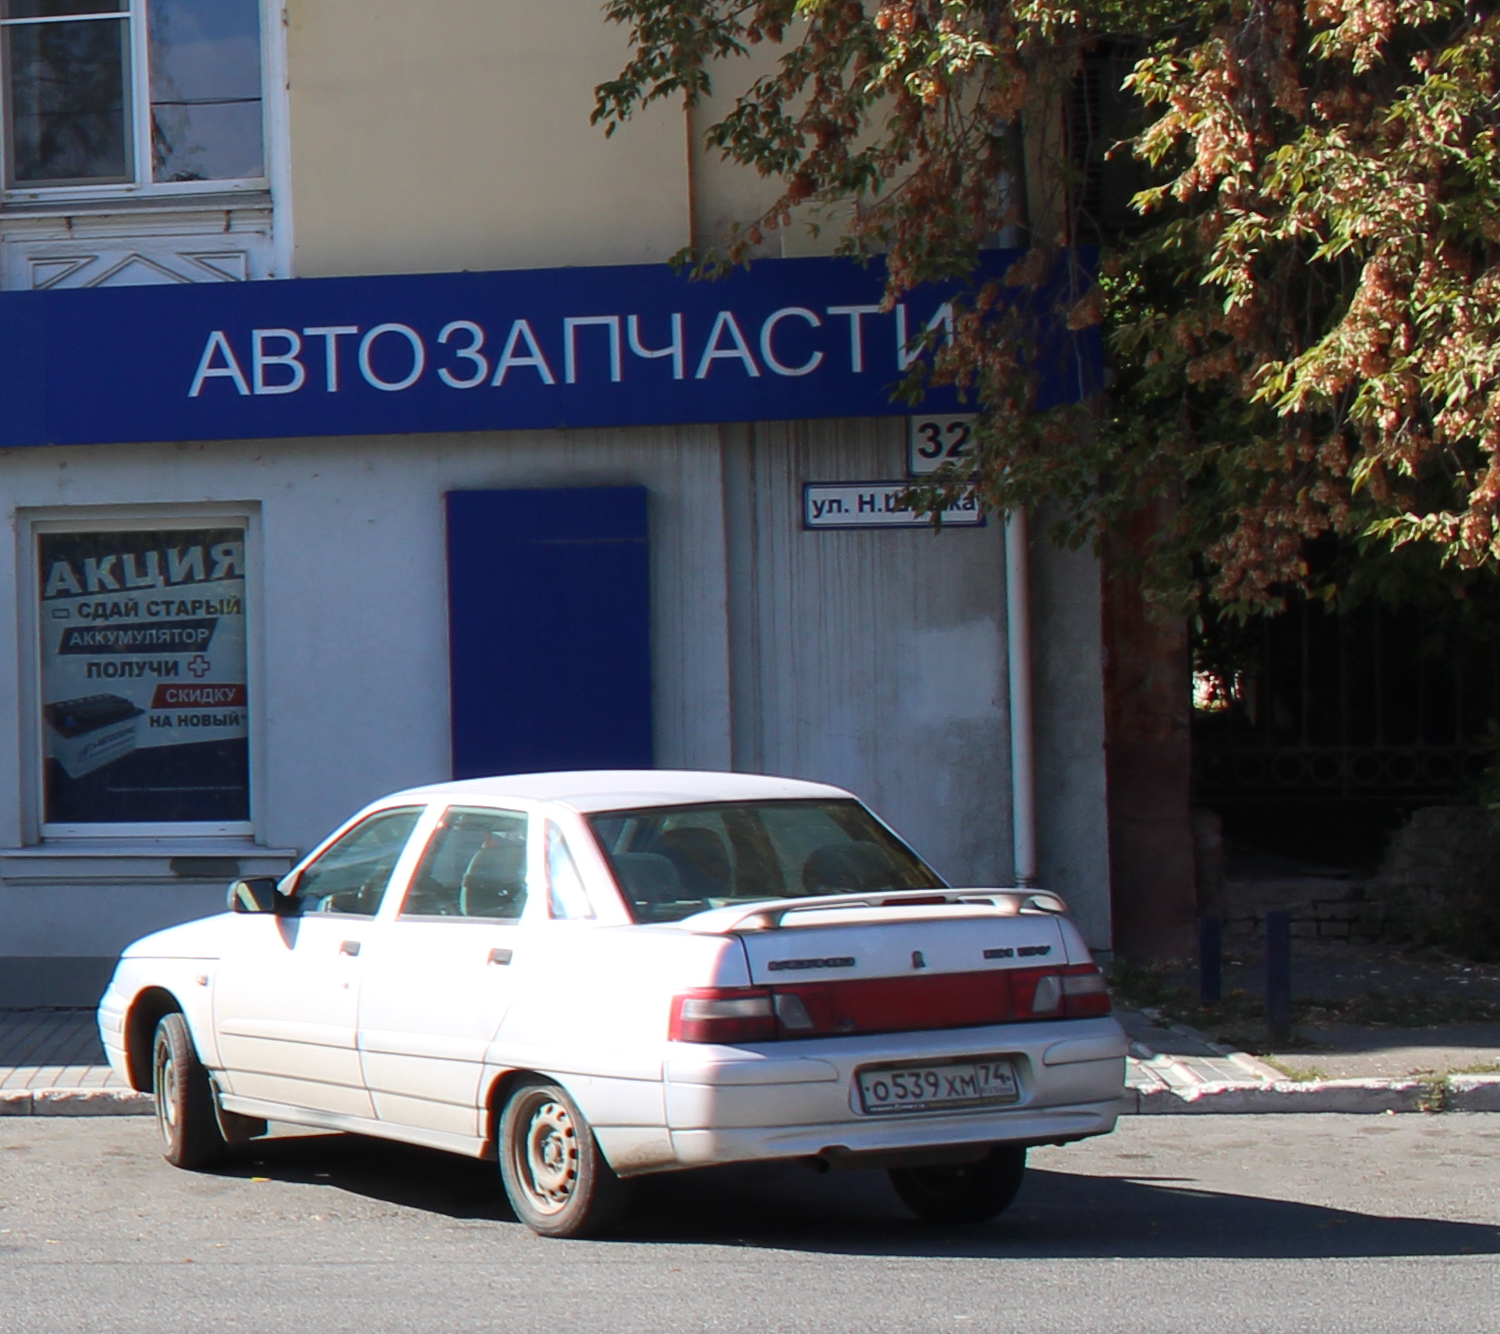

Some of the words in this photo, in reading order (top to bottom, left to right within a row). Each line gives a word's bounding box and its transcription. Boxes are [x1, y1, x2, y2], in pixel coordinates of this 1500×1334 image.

[188, 302, 954, 398] АВТОЗАПЧАСТИ
[917, 421, 971, 459] 32
[812, 498, 849, 519] ул.
[857, 493, 976, 514] Н.Шка
[44, 541, 245, 597] АКЦИЯ
[76, 598, 139, 621] СДАЙ
[145, 595, 241, 617] СТАРЫЙ
[69, 628, 210, 646] АККУМУЛЯТОР
[86, 659, 180, 679] ПОЛУЧИ
[165, 687, 237, 704] СКИДКУ
[150, 716, 173, 728] НА
[873, 1070, 978, 1102] О539ХМ
[979, 1065, 1007, 1086] 74
